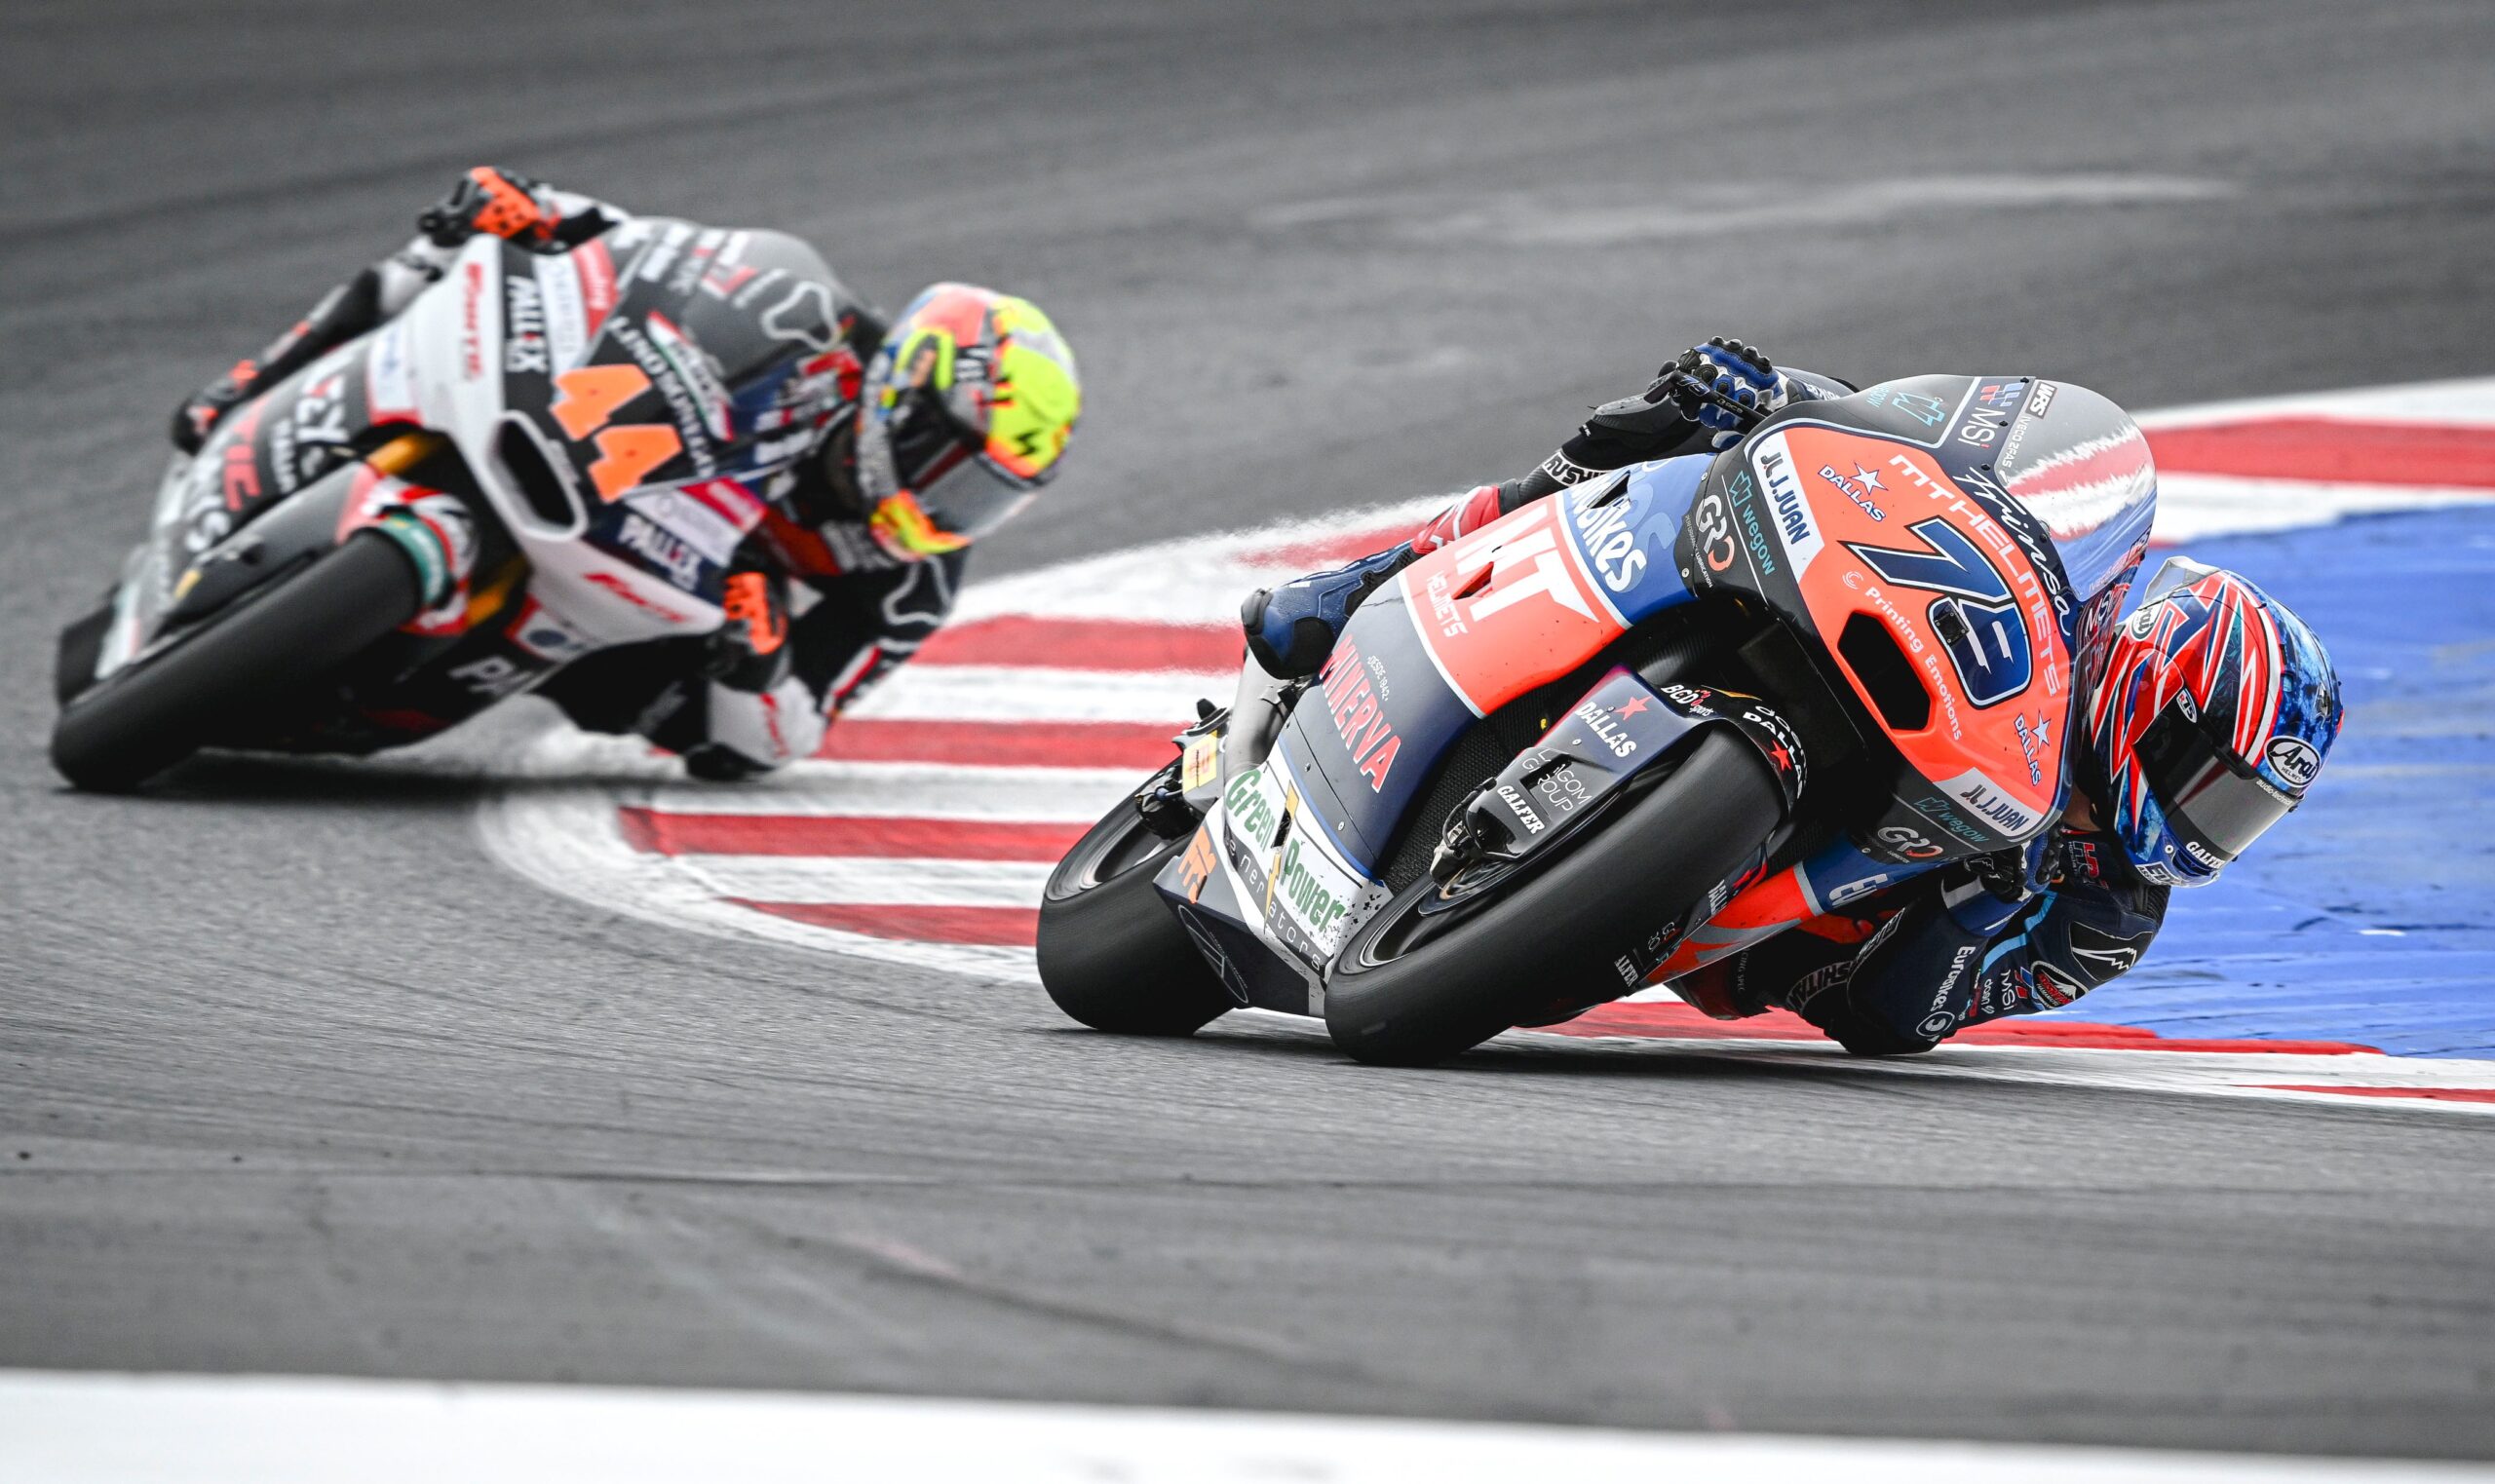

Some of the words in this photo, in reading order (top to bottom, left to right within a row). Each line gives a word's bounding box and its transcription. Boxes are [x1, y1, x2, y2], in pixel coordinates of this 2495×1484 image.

[550, 363, 682, 504] 44
[1818, 464, 1888, 522] DALLAS
[1454, 503, 1601, 624] MT
[1694, 551, 1713, 589] LUBRICATION
[1743, 503, 1776, 576] wegow
[1889, 454, 1955, 499] MT
[1949, 500, 2061, 696] HELMETS
[1427, 570, 1469, 638] HELMETS
[1835, 514, 2033, 711] 79
[1864, 587, 1925, 653] Printing
[1925, 654, 1963, 742] Emotions
[1319, 633, 1401, 794] MINERVA
[1574, 702, 1636, 758] DALLAS
[2014, 712, 2042, 786] DALLAS
[2269, 745, 2319, 780] Arai
[1225, 769, 1277, 854] Green
[1497, 784, 1546, 835] GALFER
[1938, 811, 1989, 843] wegow
[1280, 837, 1346, 932] Power
[1614, 955, 1639, 987] ALFER
